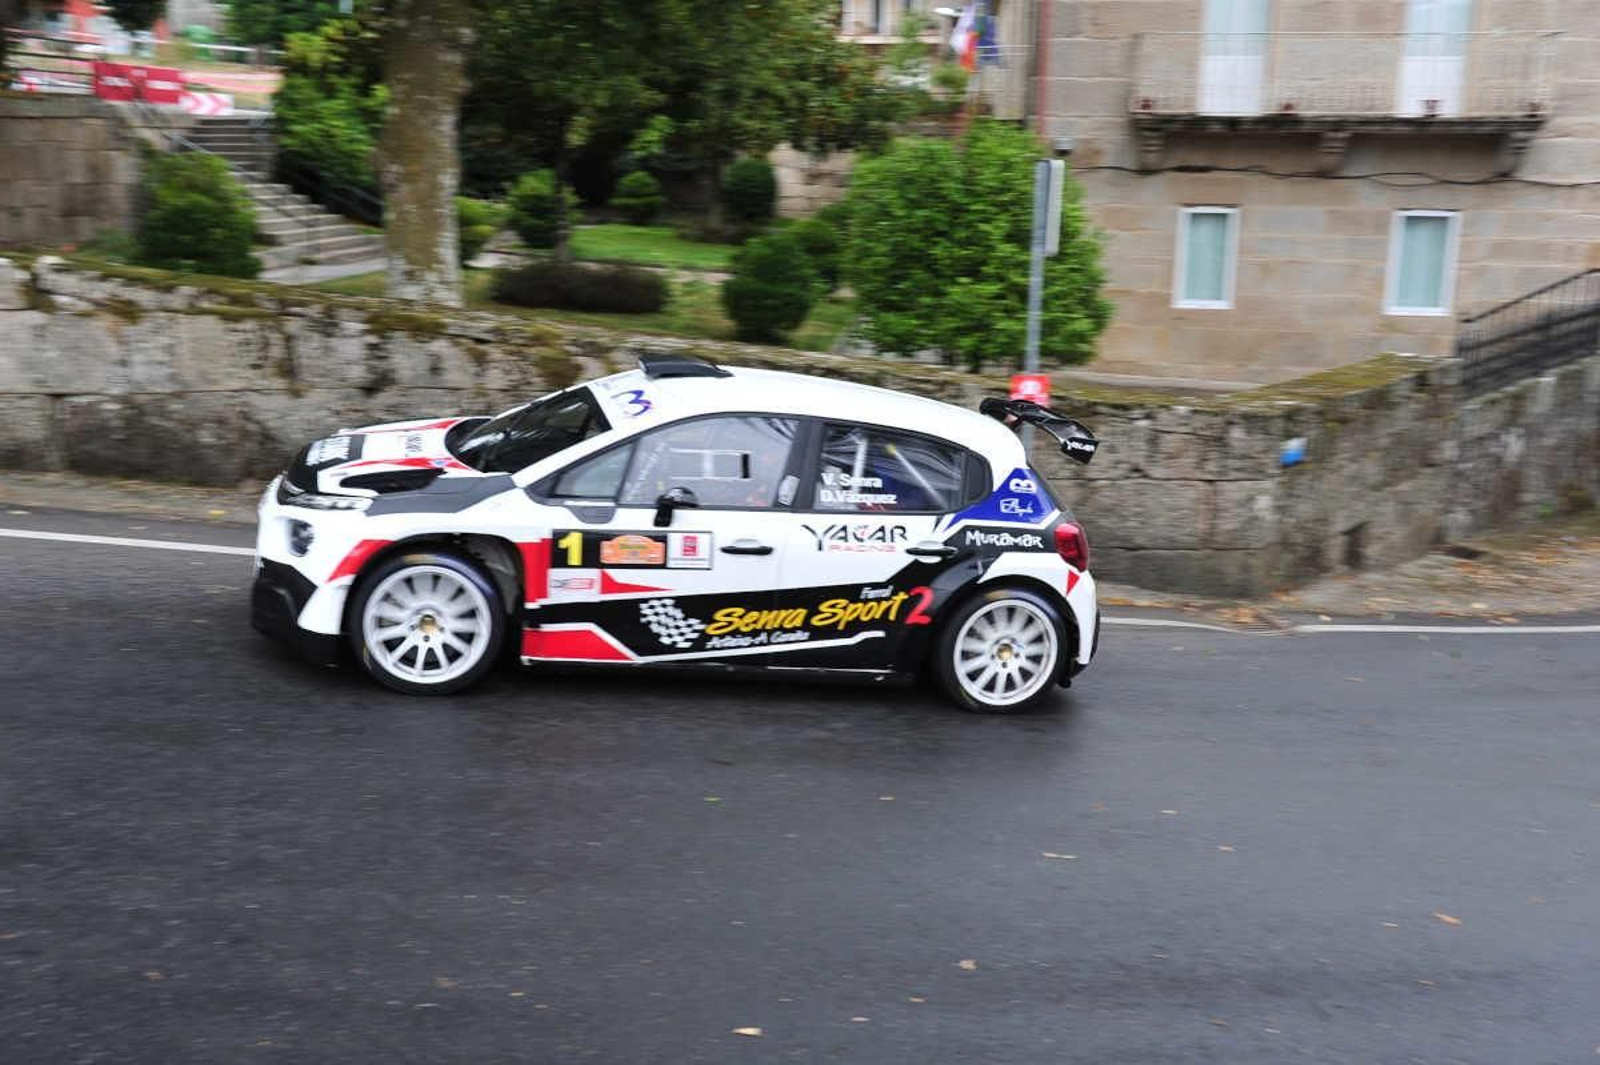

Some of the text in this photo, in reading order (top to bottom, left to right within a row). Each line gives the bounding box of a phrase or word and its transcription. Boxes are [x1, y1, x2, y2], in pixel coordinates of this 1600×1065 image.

[840, 472, 883, 489] Senra
[558, 532, 583, 566] 1
[801, 523, 908, 552] YACAR
[704, 585, 935, 636] Senra Sport 2
